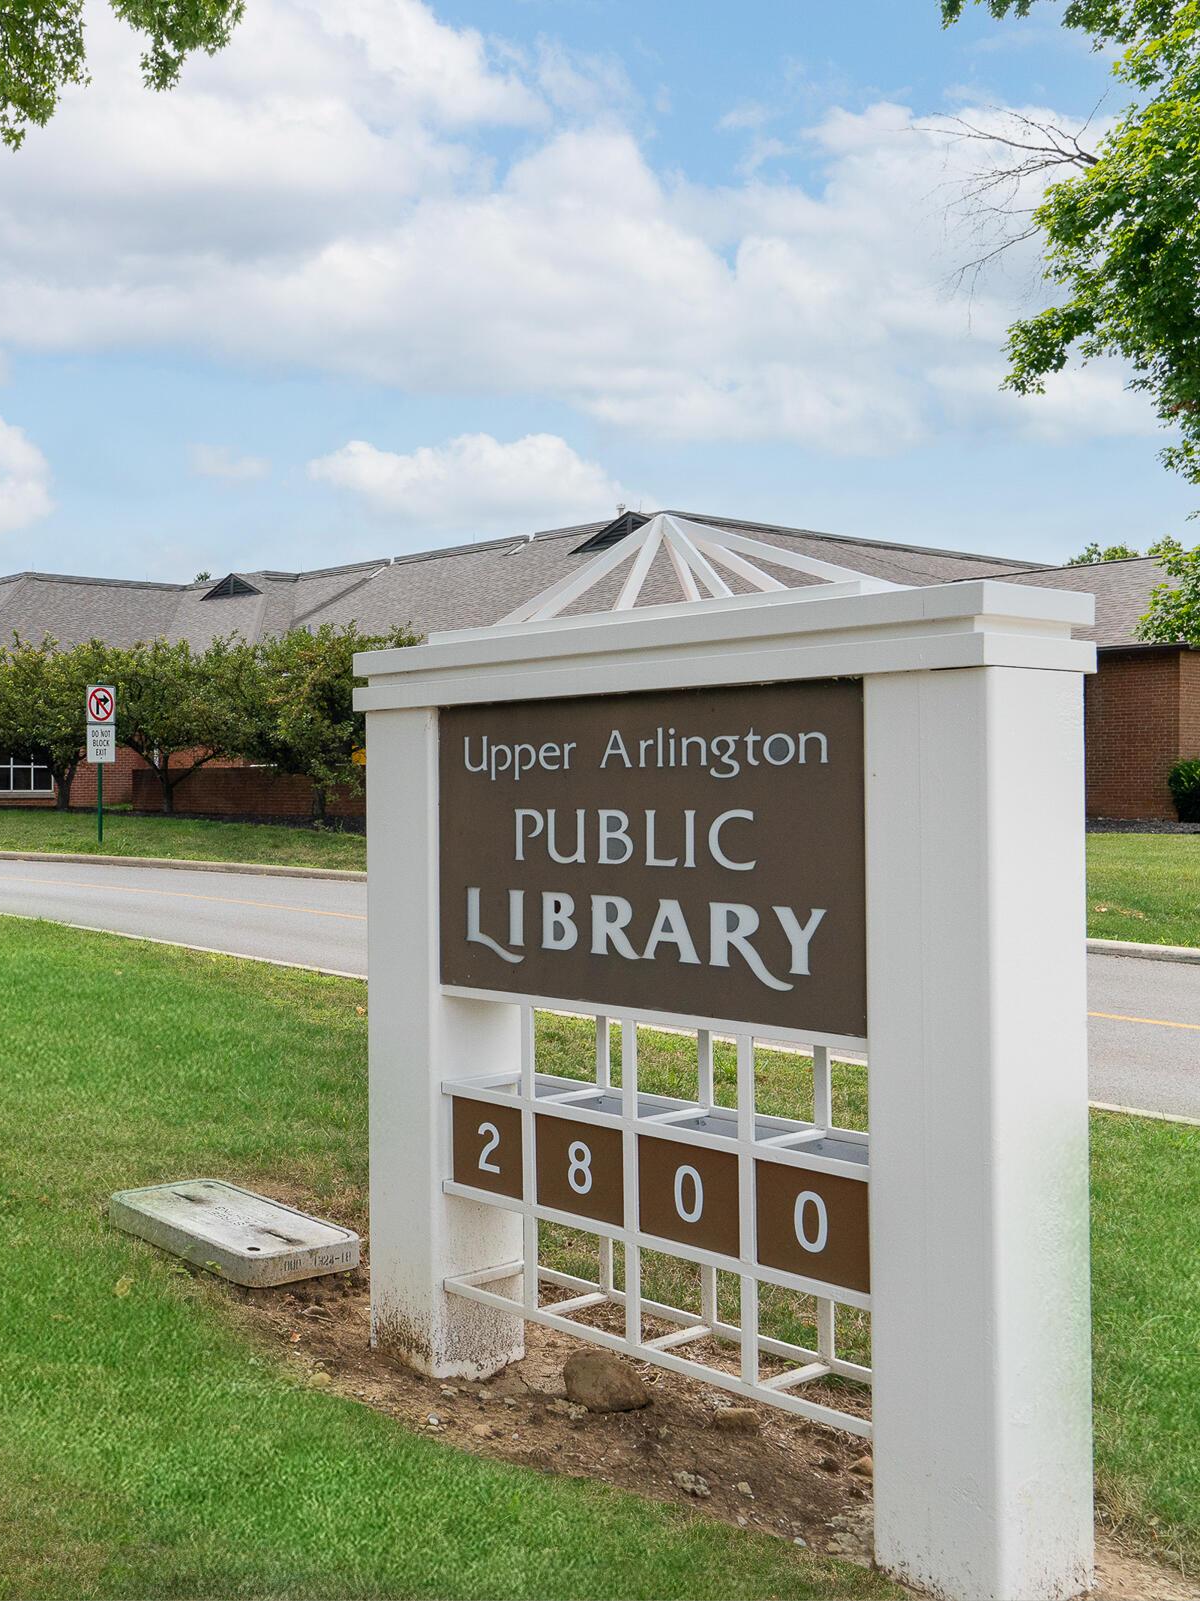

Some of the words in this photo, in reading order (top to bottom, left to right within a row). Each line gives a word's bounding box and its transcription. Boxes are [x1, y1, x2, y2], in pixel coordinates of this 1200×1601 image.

[93, 739, 110, 747] BLOCK
[96, 749, 106, 757] EXIT
[463, 735, 577, 781] Upper
[600, 727, 828, 778] Arlington
[514, 808, 757, 871] PUBLIC
[466, 886, 827, 991] LIBRARY
